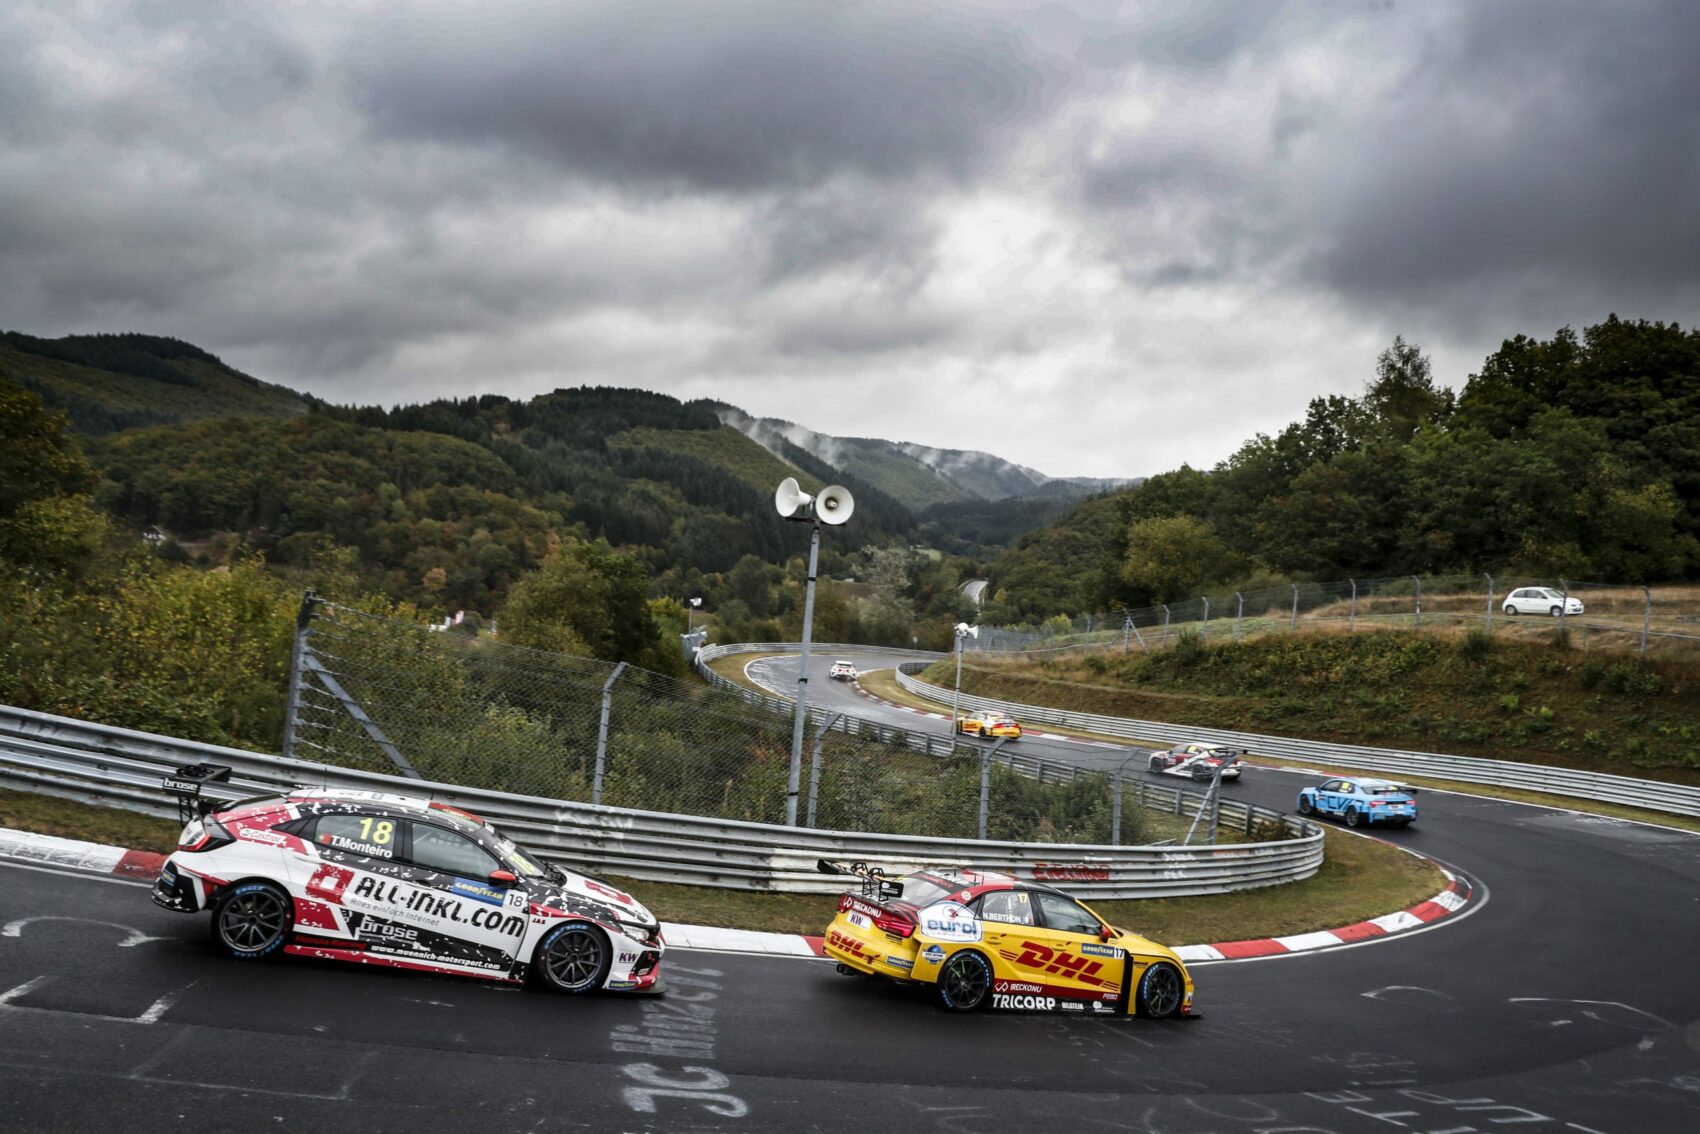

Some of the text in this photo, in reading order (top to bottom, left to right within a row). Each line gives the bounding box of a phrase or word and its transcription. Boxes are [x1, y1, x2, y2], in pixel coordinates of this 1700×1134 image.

[163, 777, 199, 791] brose
[248, 830, 284, 845] Castrol
[360, 817, 394, 844] 18
[331, 834, 394, 859] T.Monteiro
[455, 880, 504, 901] GOODYEAR
[1017, 893, 1028, 904] 17
[509, 893, 524, 907] 18
[350, 898, 441, 927] Alles einfach Internet
[982, 911, 1023, 923] N.BERTHON
[359, 916, 419, 941] brose
[828, 929, 866, 959] DHL
[1082, 943, 1114, 955] GOODYEAR
[1115, 947, 1125, 959] 17
[370, 945, 501, 971] www.muennich-motorsport.com
[618, 952, 639, 963] KW
[1014, 941, 1105, 987] DHL
[992, 993, 1057, 1011] TRICORP
